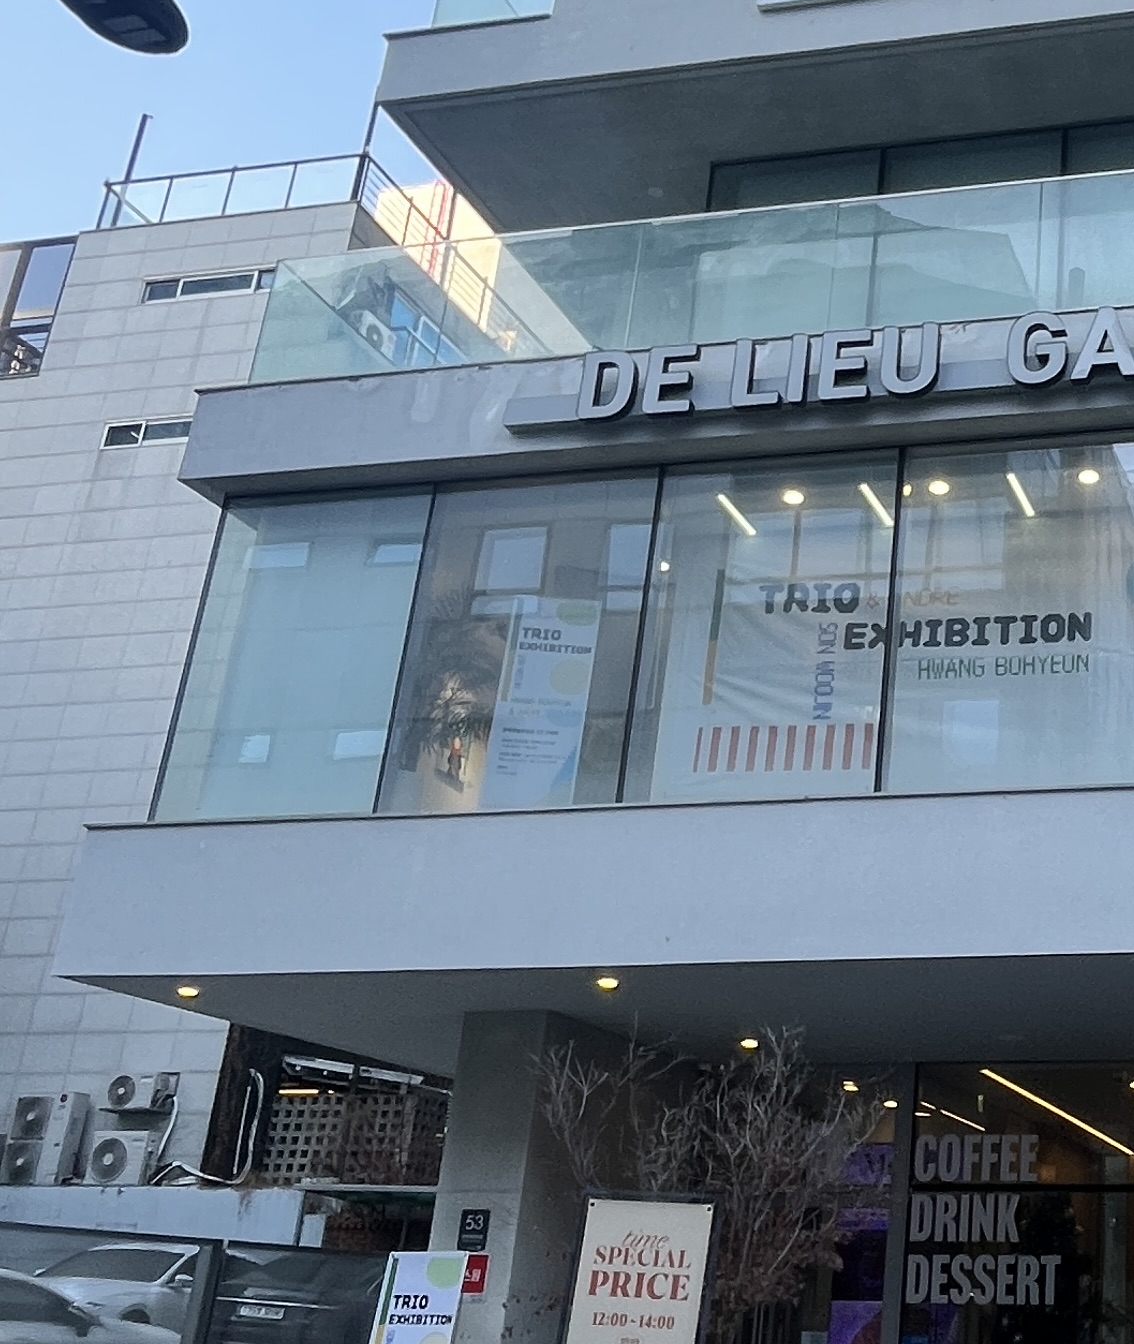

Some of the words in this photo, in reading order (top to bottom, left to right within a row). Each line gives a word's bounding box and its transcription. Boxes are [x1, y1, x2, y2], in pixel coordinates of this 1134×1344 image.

[577, 345, 700, 420] DE
[730, 321, 943, 409] LIEU
[759, 582, 861, 614] TRIO
[522, 627, 562, 642] TRIO
[843, 611, 1093, 651] EXHIBITION
[518, 641, 593, 655] EXHIBITION
[918, 656, 985, 680] HWANG
[913, 1133, 1041, 1183] COFFEE
[465, 1214, 484, 1231] 53
[909, 1192, 1022, 1244] DRINK
[621, 1229, 670, 1250] time
[593, 1244, 692, 1269] SPECIAL
[588, 1269, 691, 1301] PRICE
[905, 1253, 1062, 1306] DESSERT
[393, 1294, 430, 1311] TRIO
[388, 1313, 454, 1326] EXHIBITION
